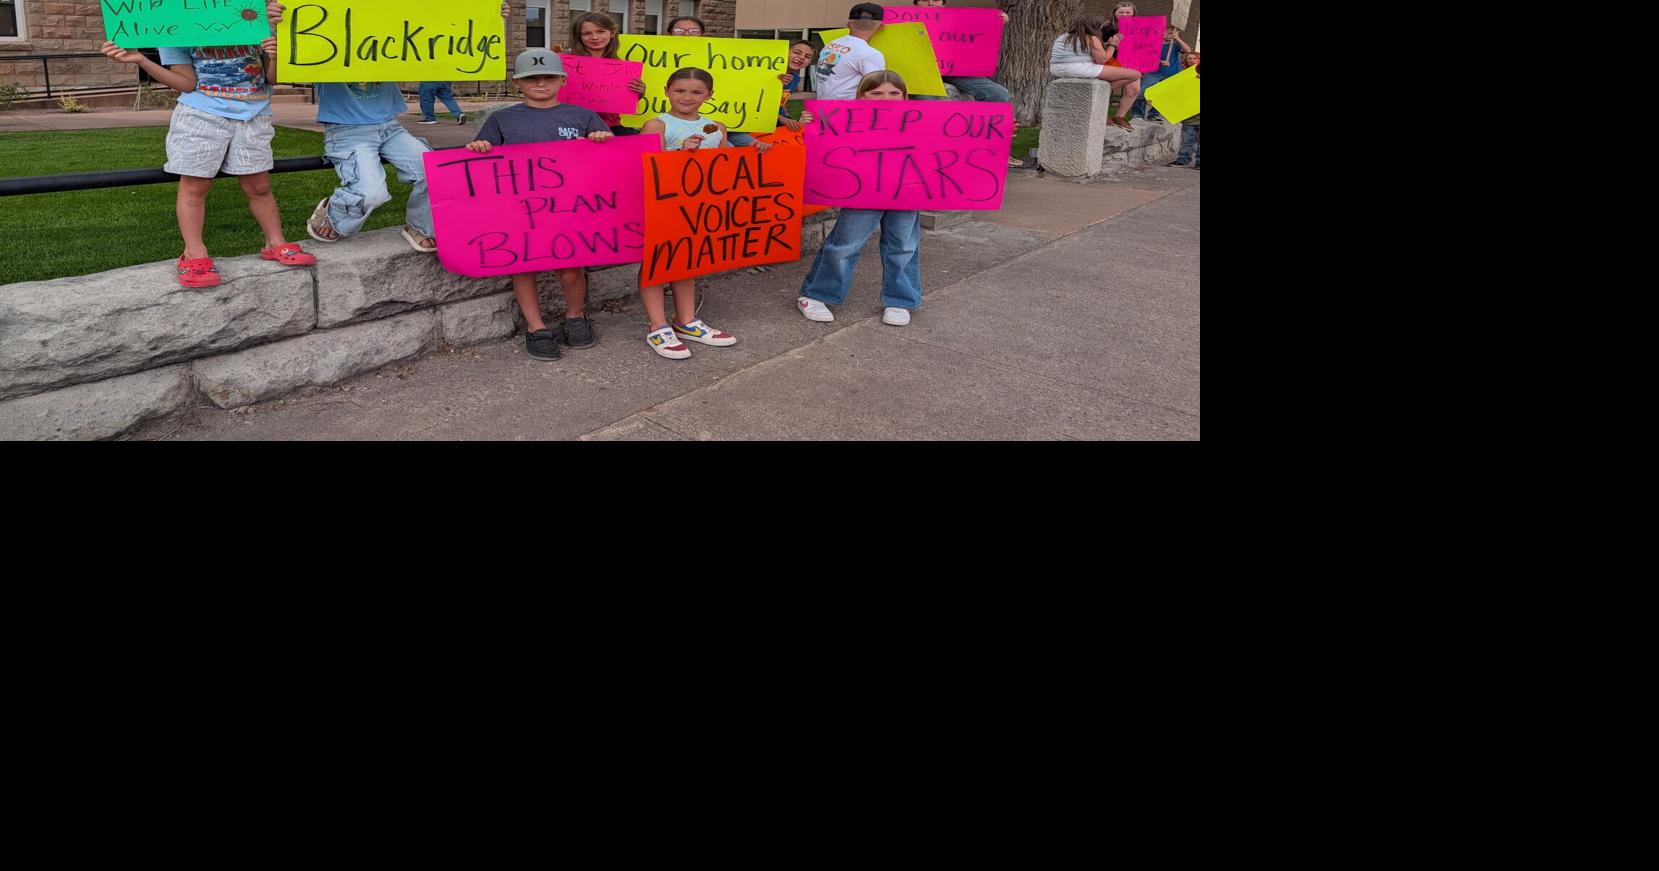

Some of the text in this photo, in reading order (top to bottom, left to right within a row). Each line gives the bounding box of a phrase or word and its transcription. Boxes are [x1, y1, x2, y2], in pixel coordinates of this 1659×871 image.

[112, 20, 180, 42] Alive
[288, 4, 501, 74] Blackridge
[707, 43, 785, 71] home
[818, 107, 1005, 140] KEEP OUR
[437, 155, 565, 198] THIS
[650, 152, 785, 201] LOCAL
[809, 145, 1000, 202] STARS
[519, 190, 617, 230] PLAN
[678, 192, 795, 236] VOICES
[467, 220, 645, 269] BLOWS
[648, 223, 794, 281] MATTER
